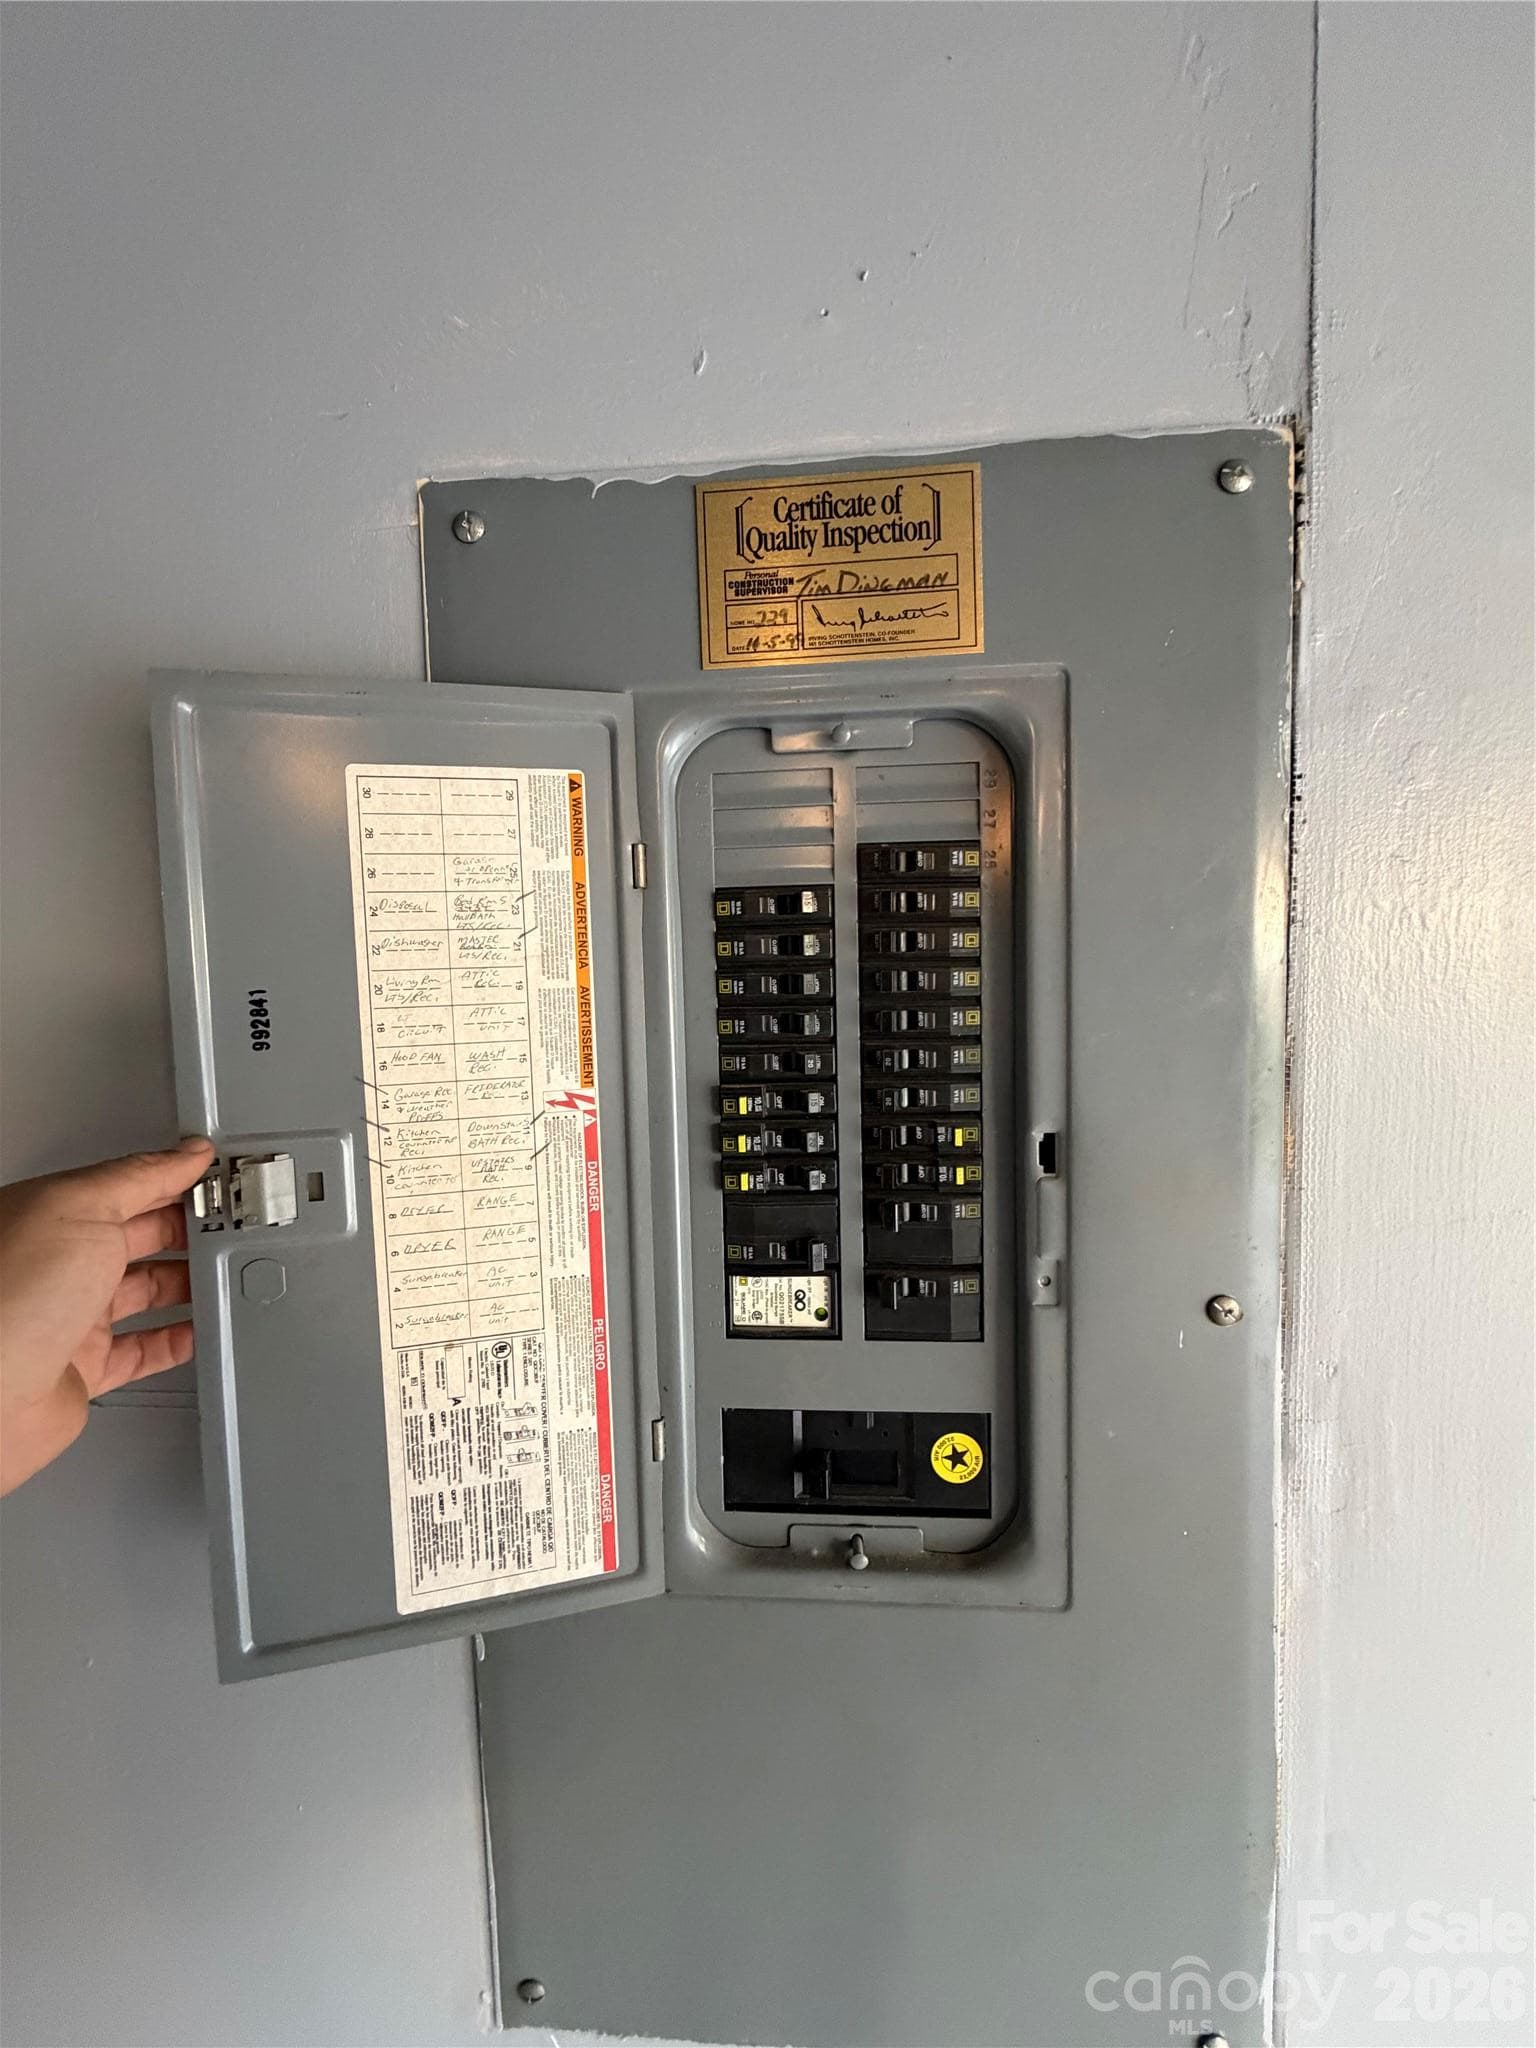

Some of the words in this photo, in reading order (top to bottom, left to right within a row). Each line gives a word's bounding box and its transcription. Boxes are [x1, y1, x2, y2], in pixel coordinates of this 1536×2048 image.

[773, 490, 876, 523] Certificate
[881, 484, 904, 514] of
[746, 522, 818, 560] Quality
[822, 517, 932, 553] Inspection
[744, 570, 779, 580] Personal
[728, 577, 794, 589] CONSTRUCTION
[734, 586, 789, 597] SUPERVISOR
[362, 787, 371, 799] 30
[505, 790, 514, 801] 29
[572, 797, 584, 857] WARNING
[365, 828, 374, 839] 28
[507, 829, 516, 839] 27
[367, 867, 376, 879] 26
[369, 906, 378, 917] 24
[512, 904, 520, 915] 23
[575, 881, 589, 970] ADVERTENCIA
[371, 944, 381, 956] 22
[513, 941, 522, 952] 21
[374, 984, 383, 996] 20
[515, 980, 523, 991] 19
[248, 988, 271, 1051] 992841
[517, 1016, 525, 1026] 17
[376, 1022, 385, 1033] 18
[580, 985, 594, 1087] AVERTISSEMENT
[420, 1052, 442, 1062] FAN
[468, 1047, 505, 1060] WASH
[519, 1053, 528, 1063] 15
[378, 1061, 388, 1071] 16
[520, 1090, 529, 1101] 13
[381, 1100, 390, 1110] 14
[383, 1136, 393, 1147] 12
[386, 1175, 395, 1185] 10
[588, 1160, 600, 1212] DANGER
[477, 1193, 518, 1207] RANGE
[482, 1225, 526, 1241] RANGE
[794, 1289, 807, 1312] QO
[594, 1318, 606, 1371] PELIGRO
[452, 1398, 462, 1407] A
[600, 1473, 613, 1524] DANGER
[546, 1507, 552, 1515] DE
